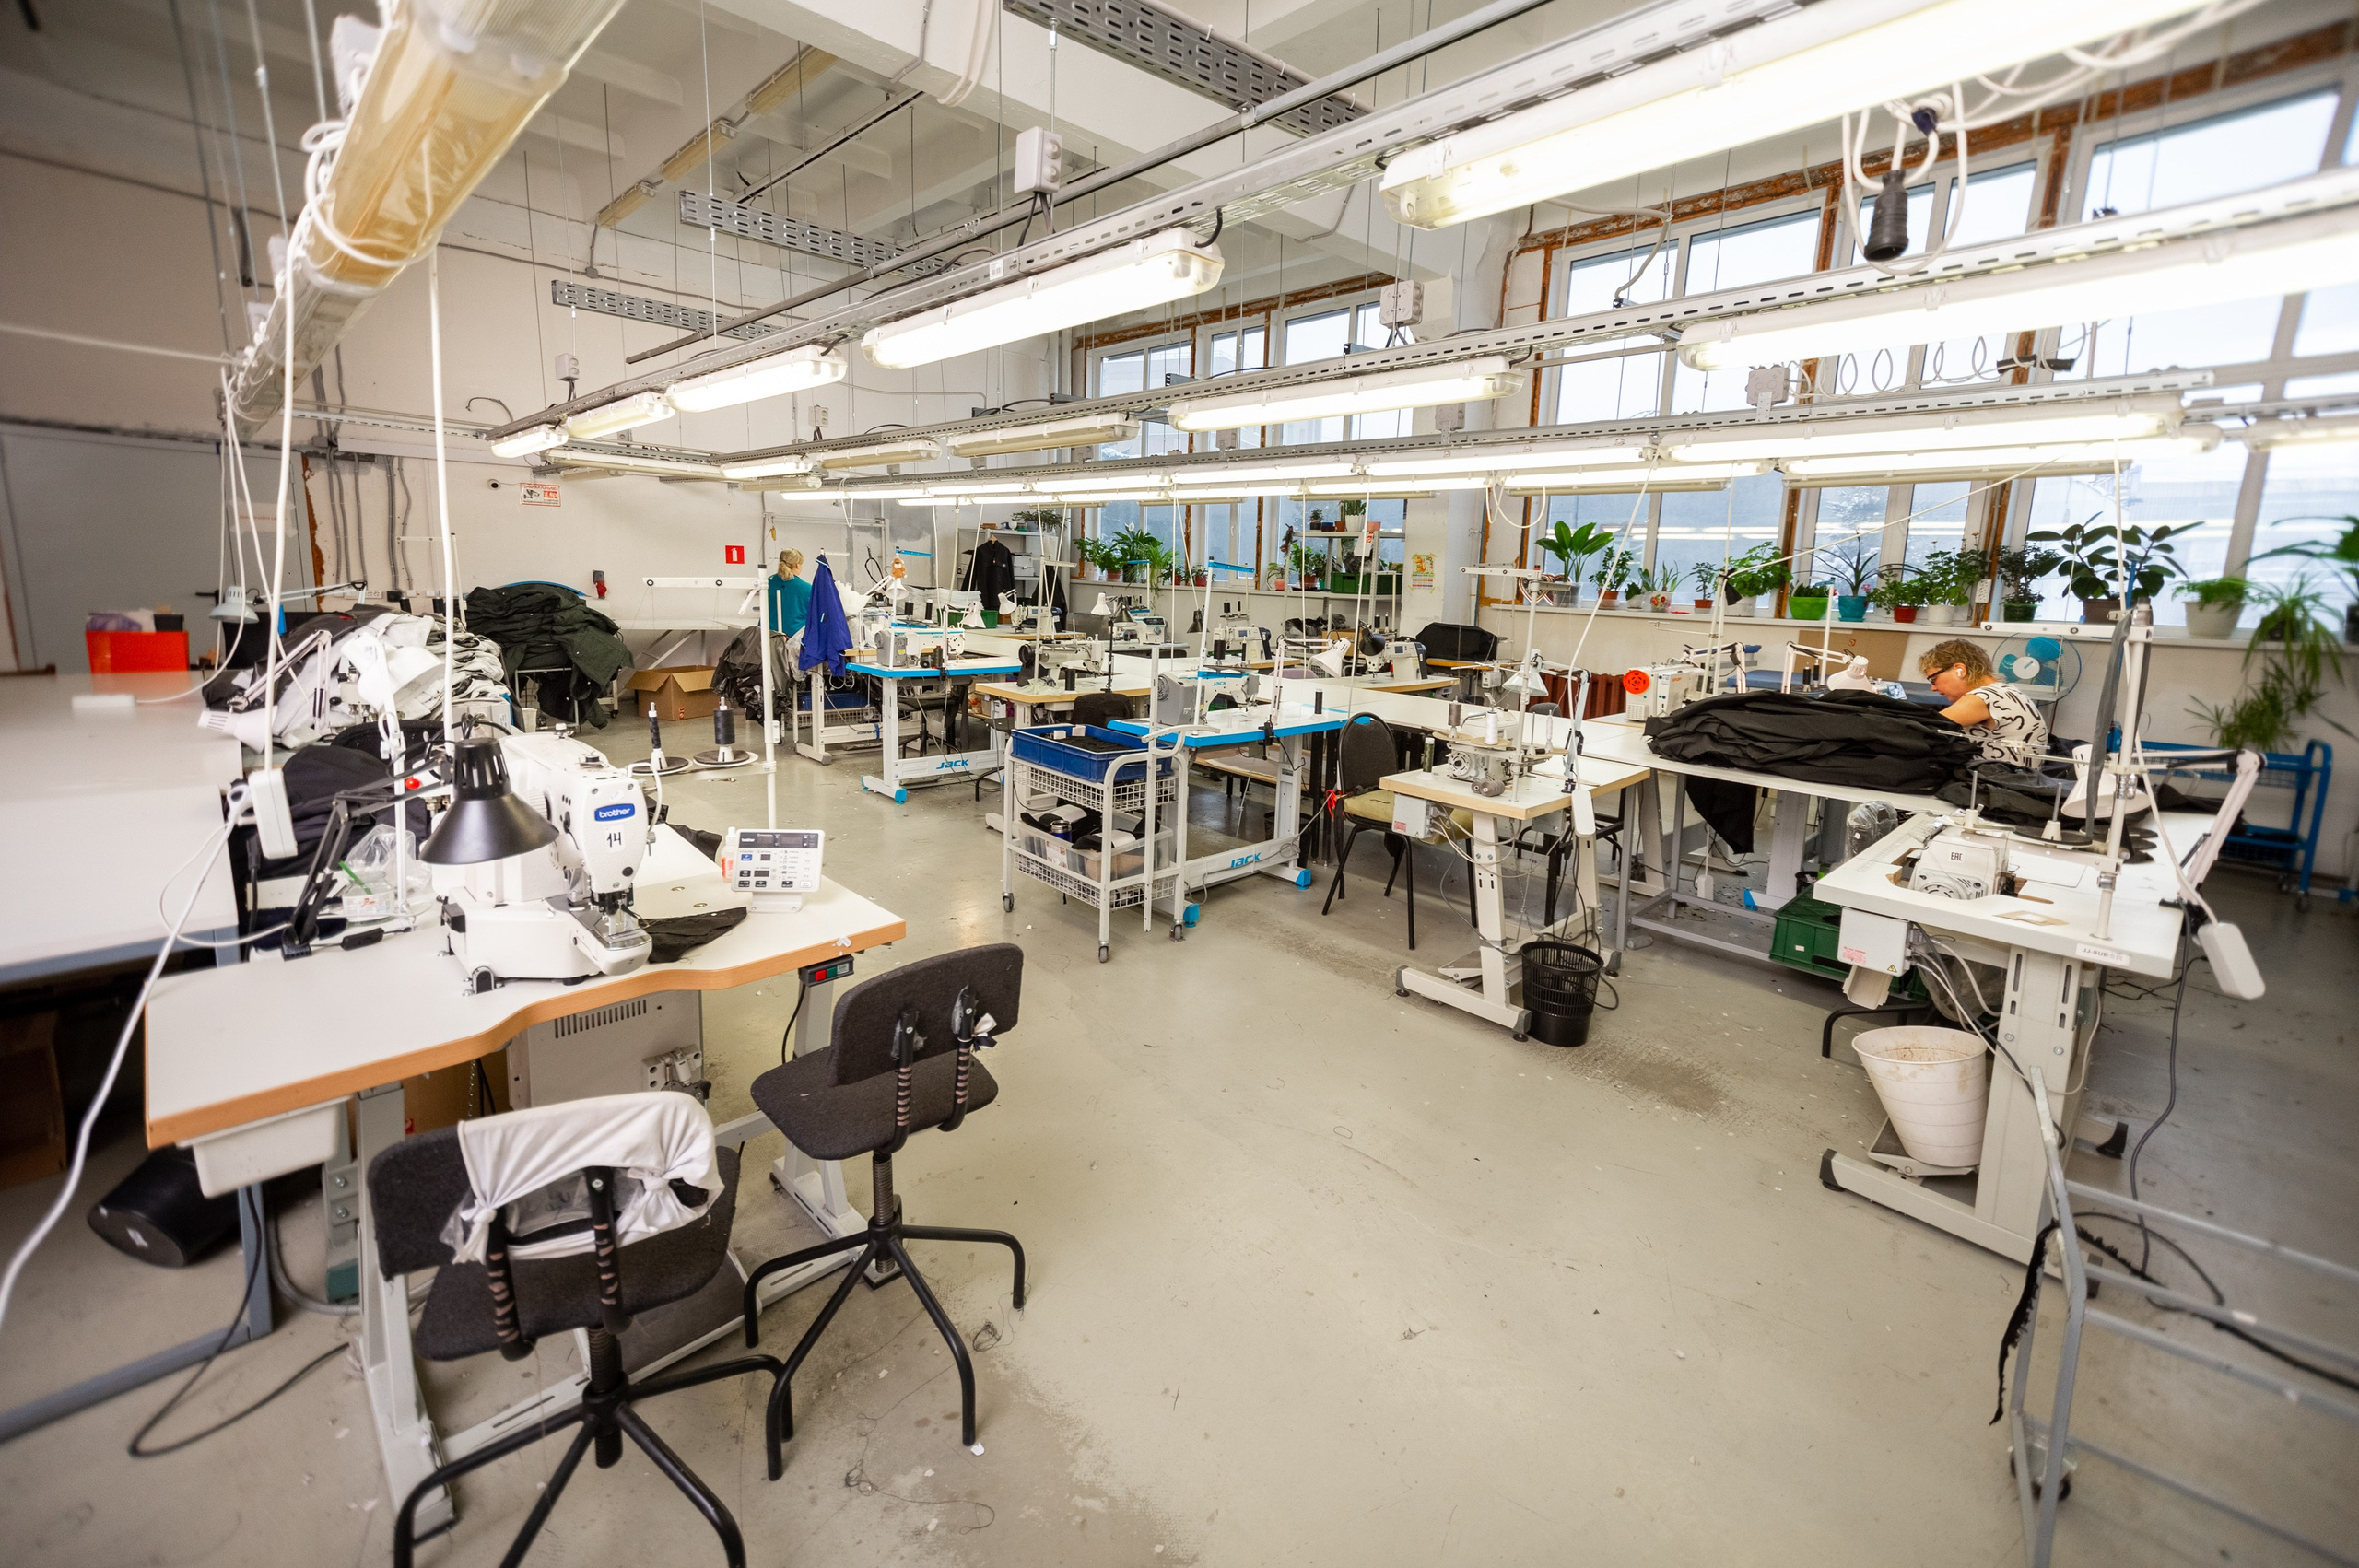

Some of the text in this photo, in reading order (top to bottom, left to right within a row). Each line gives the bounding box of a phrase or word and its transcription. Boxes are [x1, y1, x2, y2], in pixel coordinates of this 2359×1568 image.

[936, 758, 969, 770] JACK
[599, 808, 631, 818] brother
[607, 831, 622, 848] 14
